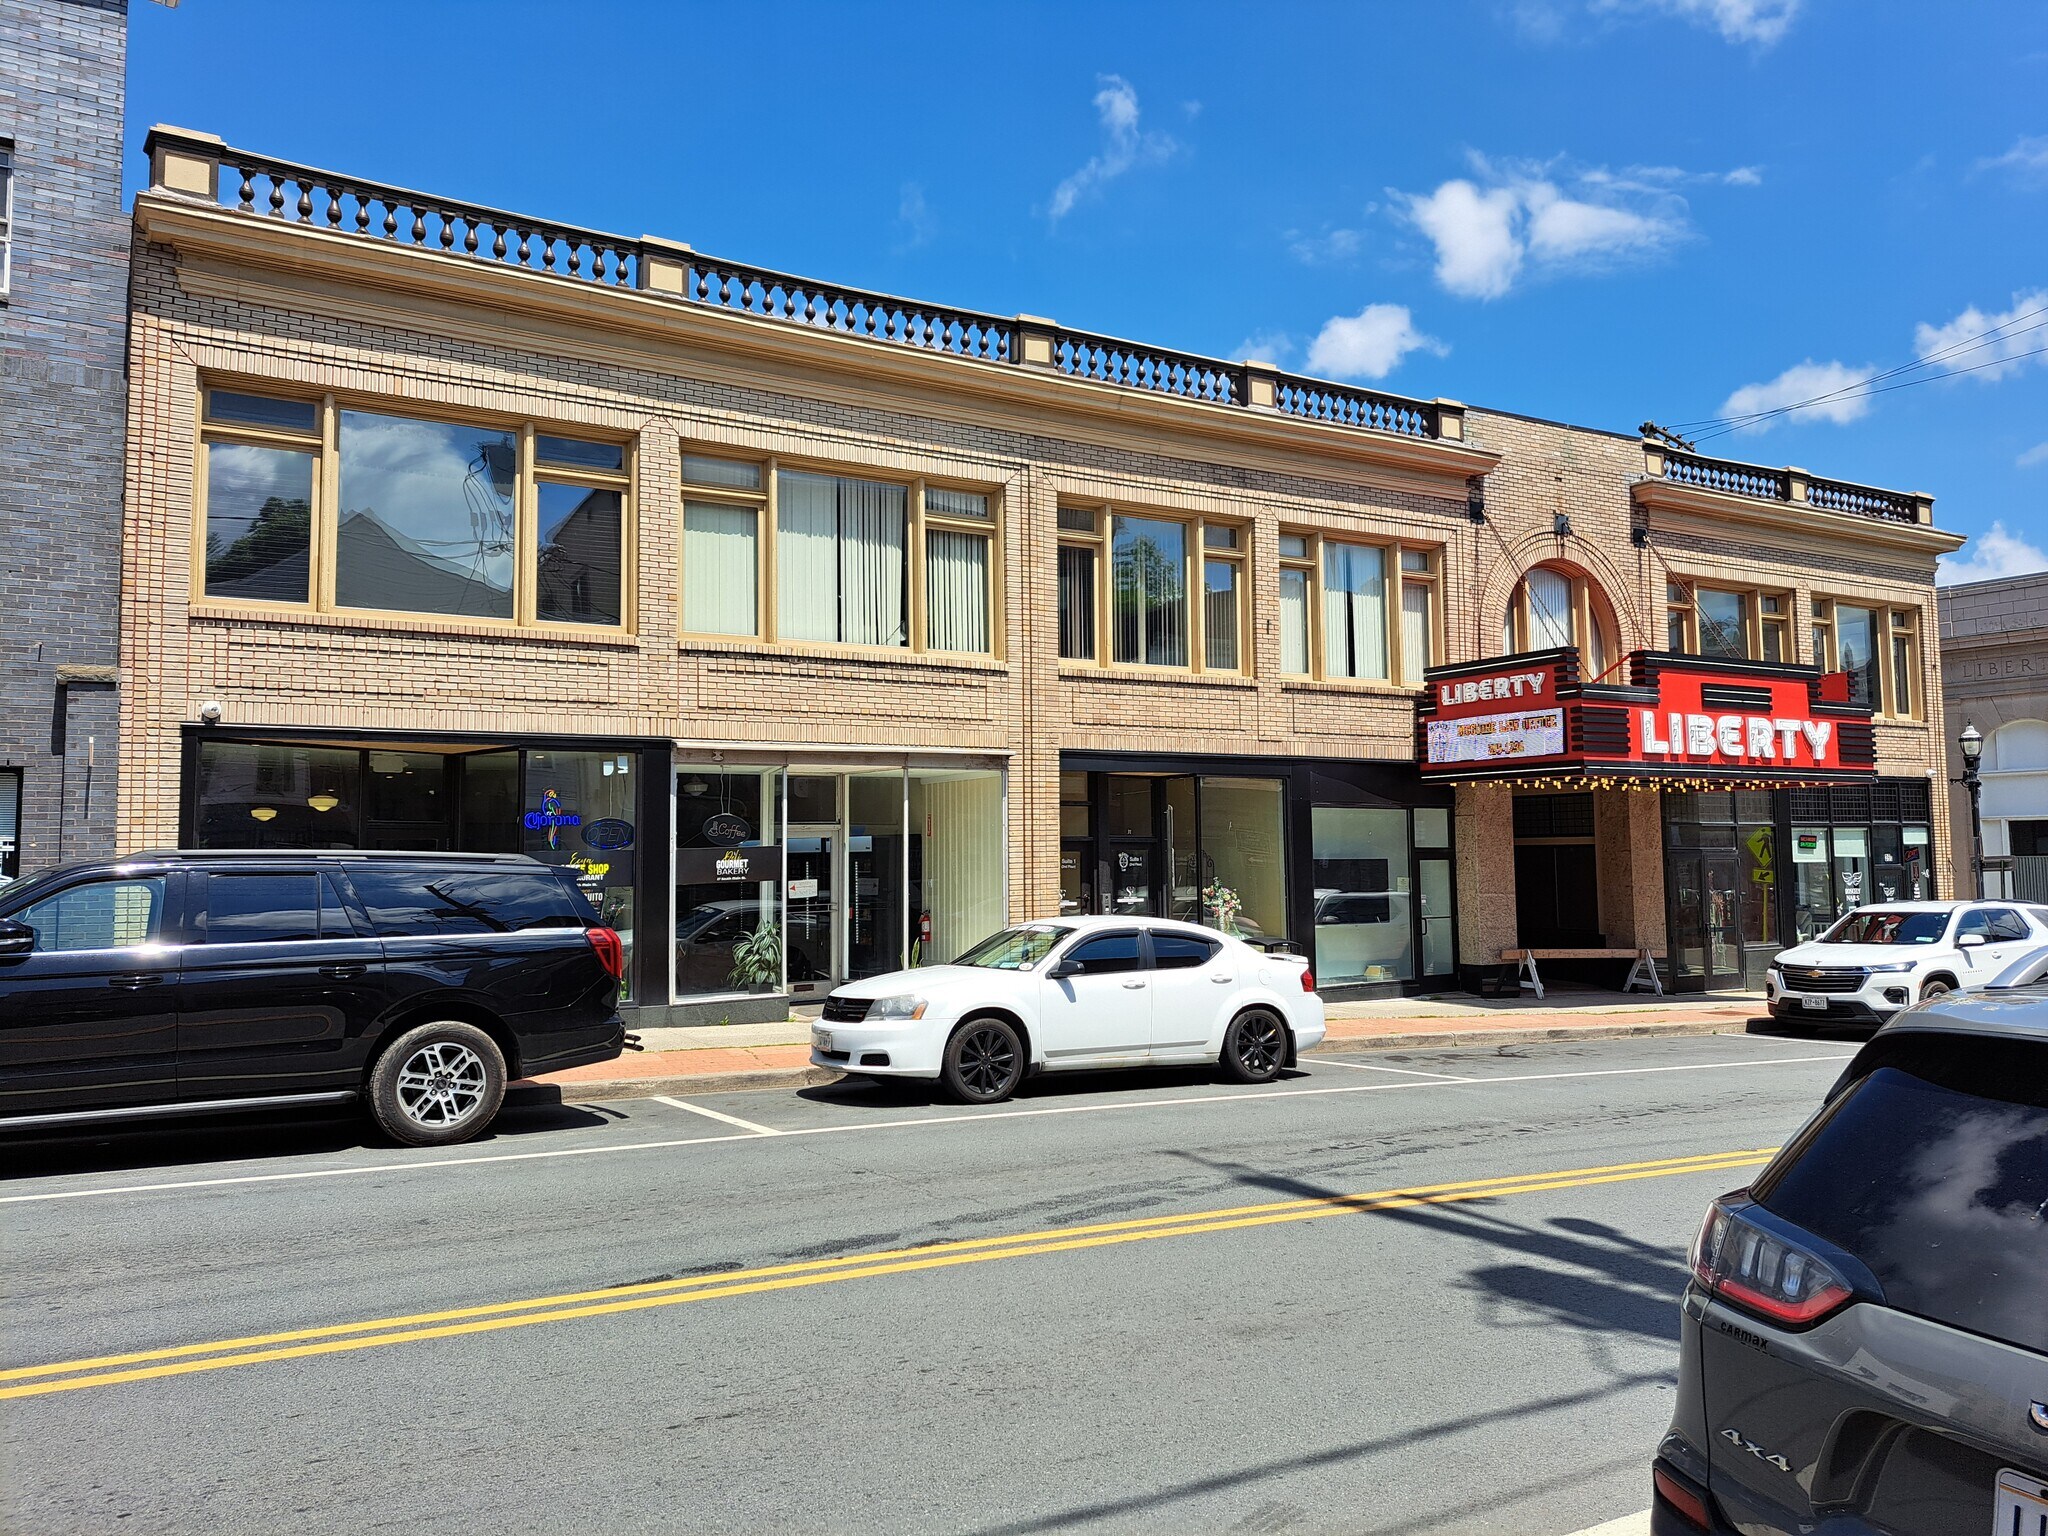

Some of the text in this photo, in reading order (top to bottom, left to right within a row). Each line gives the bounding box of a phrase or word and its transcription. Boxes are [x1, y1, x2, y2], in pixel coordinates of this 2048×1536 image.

[1441, 672, 1546, 706] LIBERTY
[1640, 710, 1832, 760] LIBERTY
[524, 811, 580, 830] Corona
[587, 826, 631, 842] OPEN
[719, 823, 746, 839] Coffee
[587, 863, 610, 875] SHOP
[716, 859, 749, 869] GOURMET
[716, 868, 749, 876] BAKERY
